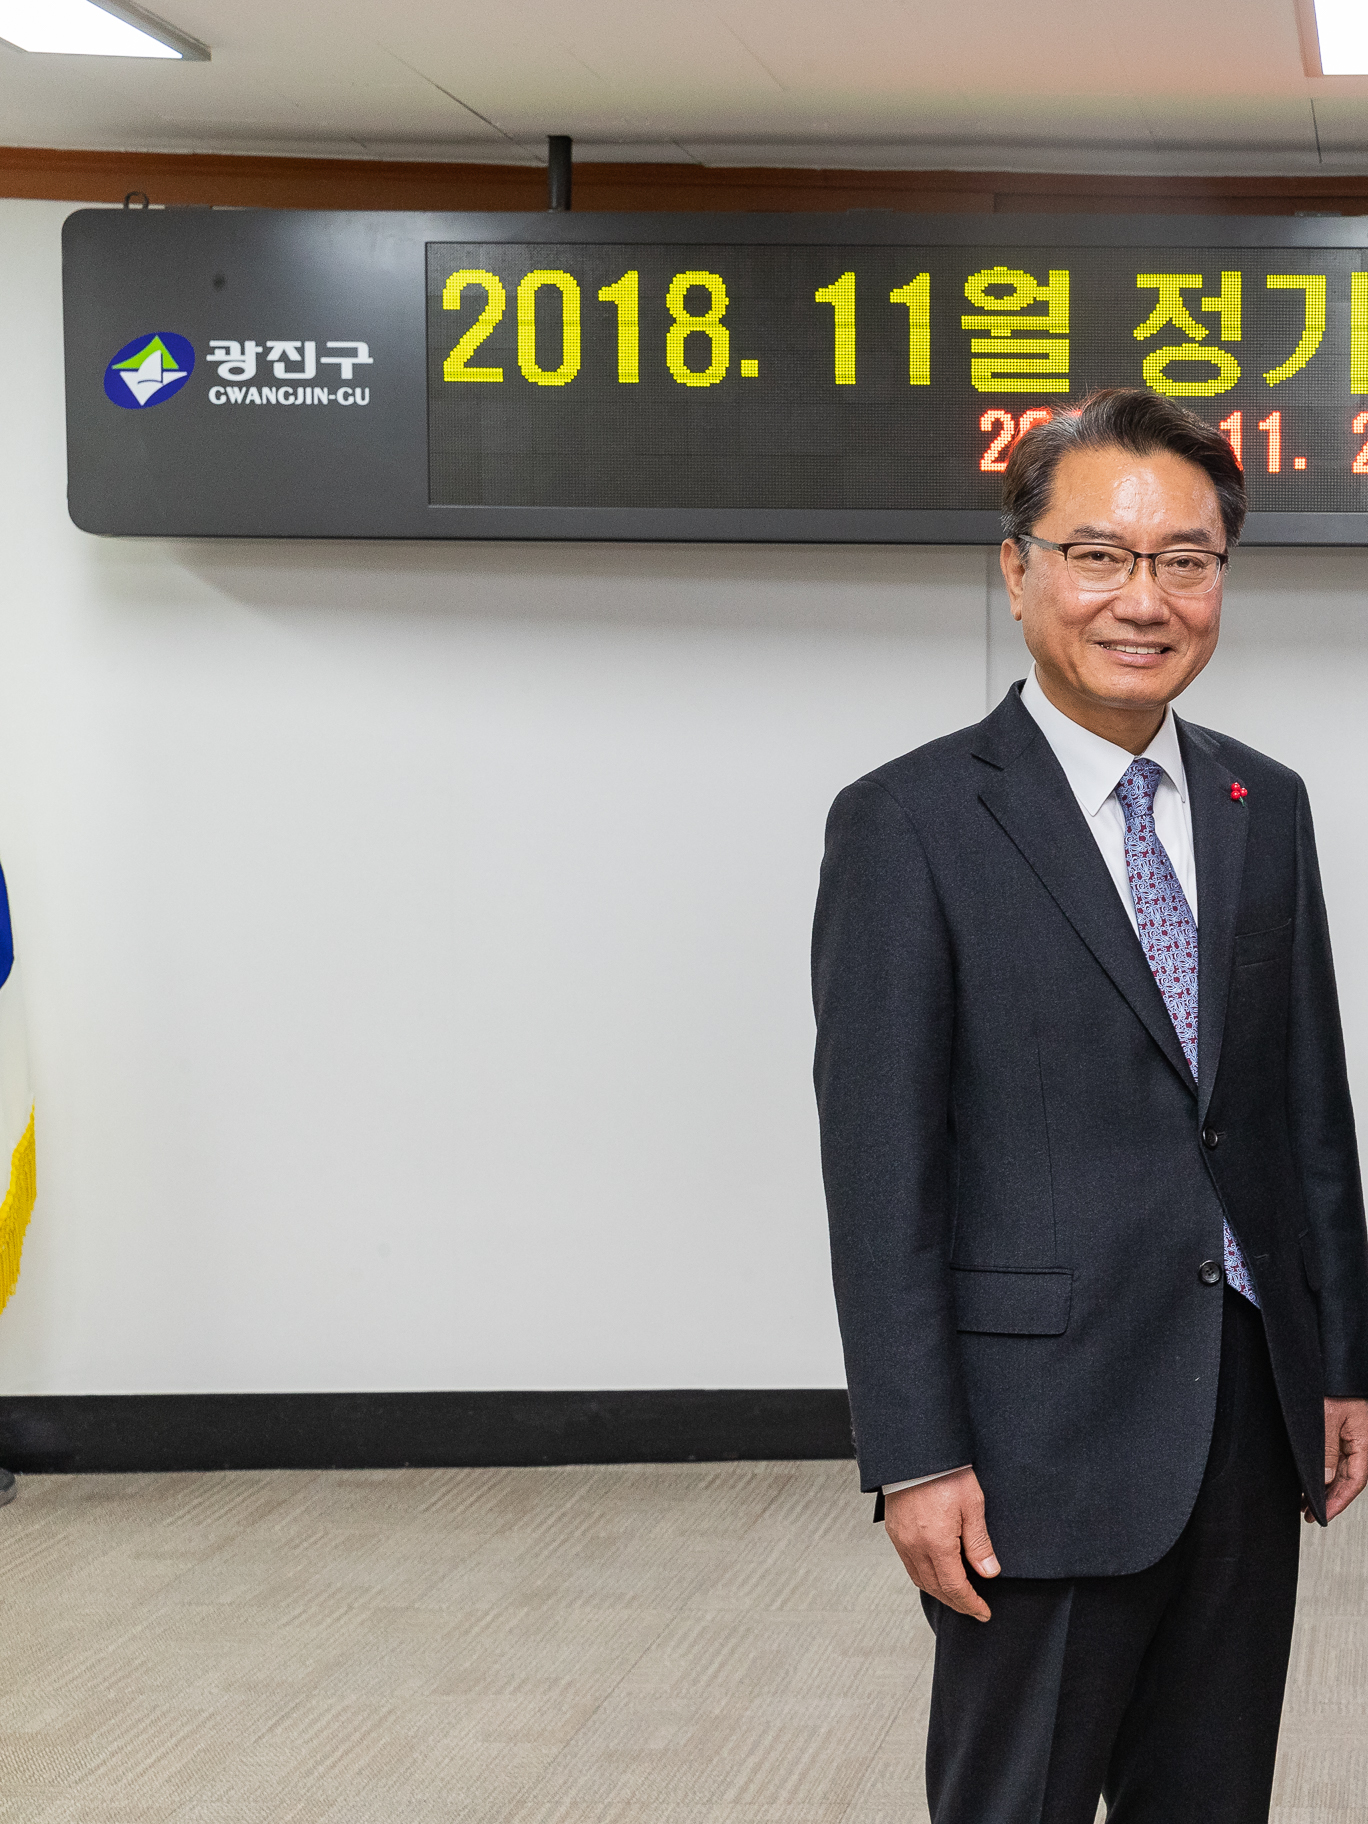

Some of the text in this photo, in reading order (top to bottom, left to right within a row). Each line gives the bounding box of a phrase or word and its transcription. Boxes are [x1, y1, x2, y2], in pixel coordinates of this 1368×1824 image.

[442, 269, 760, 387] 2018.
[815, 266, 1071, 394] 11월
[206, 339, 374, 381] 광진구
[208, 385, 370, 406] GWANGJIN-GU
